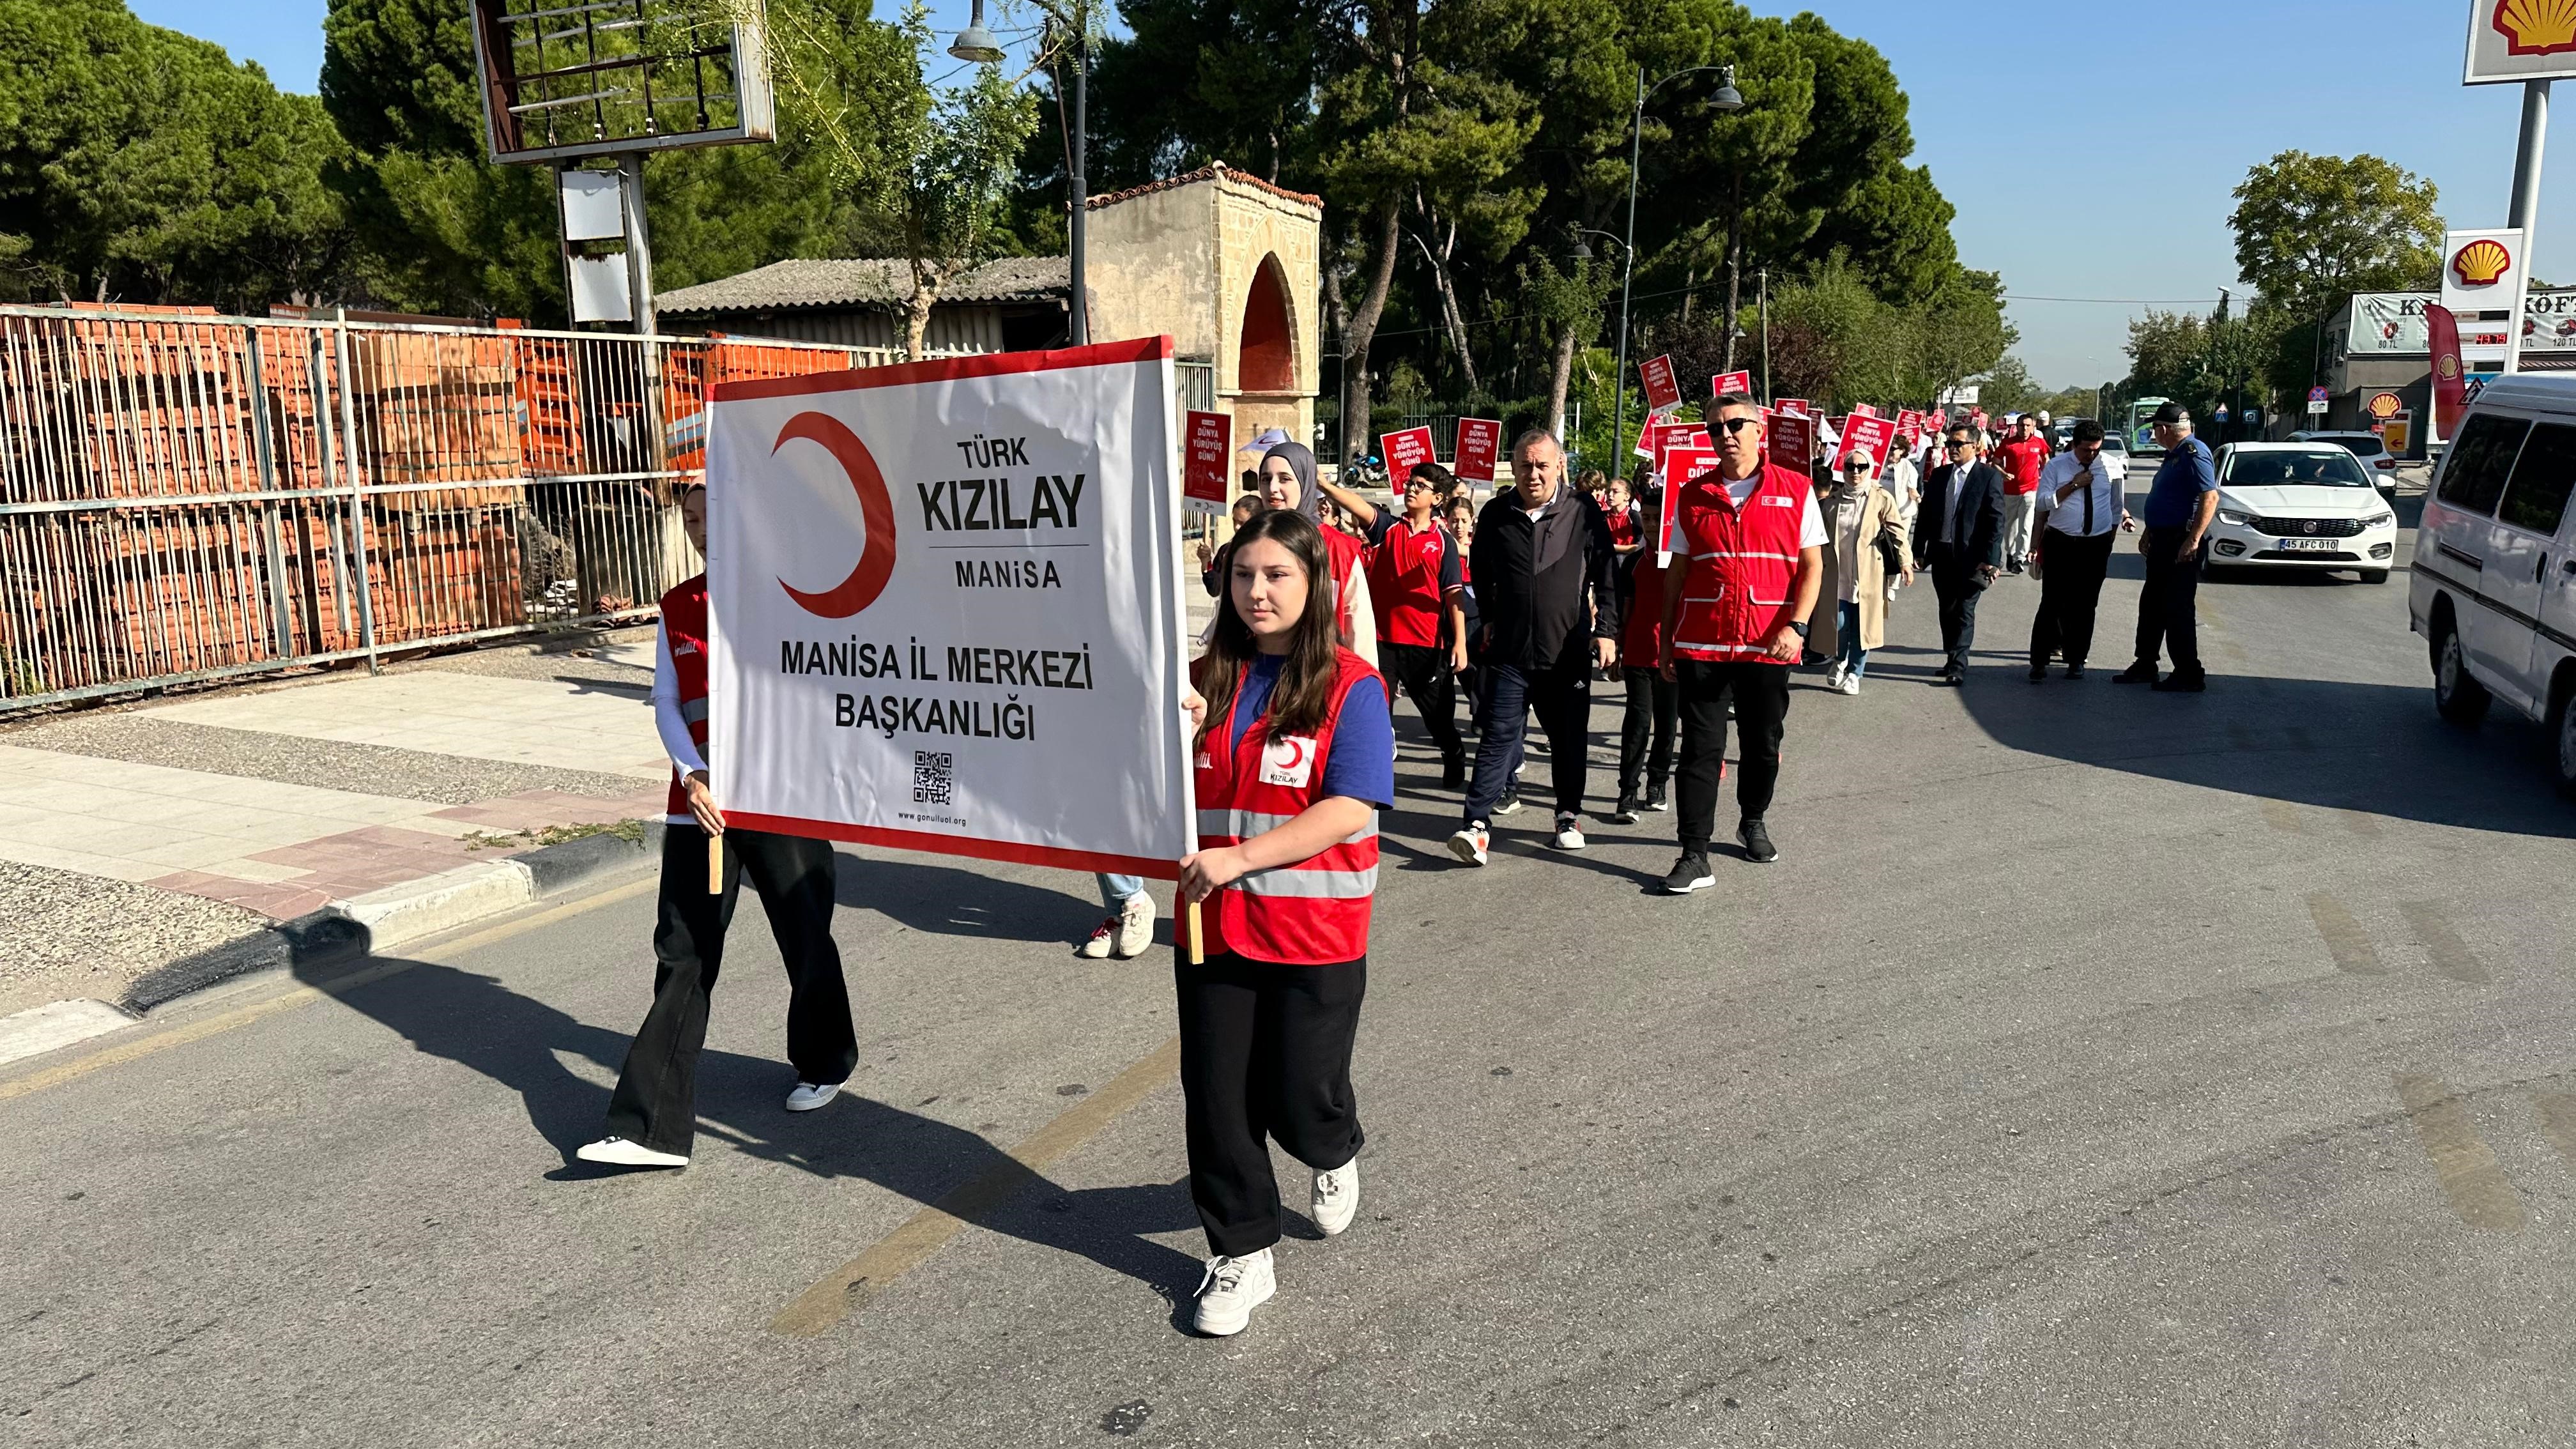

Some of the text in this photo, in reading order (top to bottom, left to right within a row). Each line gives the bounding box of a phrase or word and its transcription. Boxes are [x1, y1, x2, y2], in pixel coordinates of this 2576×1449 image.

[2378, 339, 2398, 349] 80 TL
[2552, 337, 2566, 347] 120
[1197, 426, 1219, 439] DÜNYA
[1469, 429, 1489, 438] DÜNYA
[956, 434, 1030, 468] TÜRK
[1192, 437, 1223, 454] YÜRÜYÜŞ
[1395, 440, 1420, 451] DÜNYA
[1198, 450, 1216, 462] GÜNÜ
[917, 474, 1085, 531] KIZILAY
[2285, 540, 2297, 548] 45
[2299, 540, 2317, 549] AFC
[781, 634, 1093, 690] MANİSA İL MERKEZİ
[836, 693, 1035, 740] BAŞKANLIĞI
[1270, 773, 1298, 783] KIZILAY
